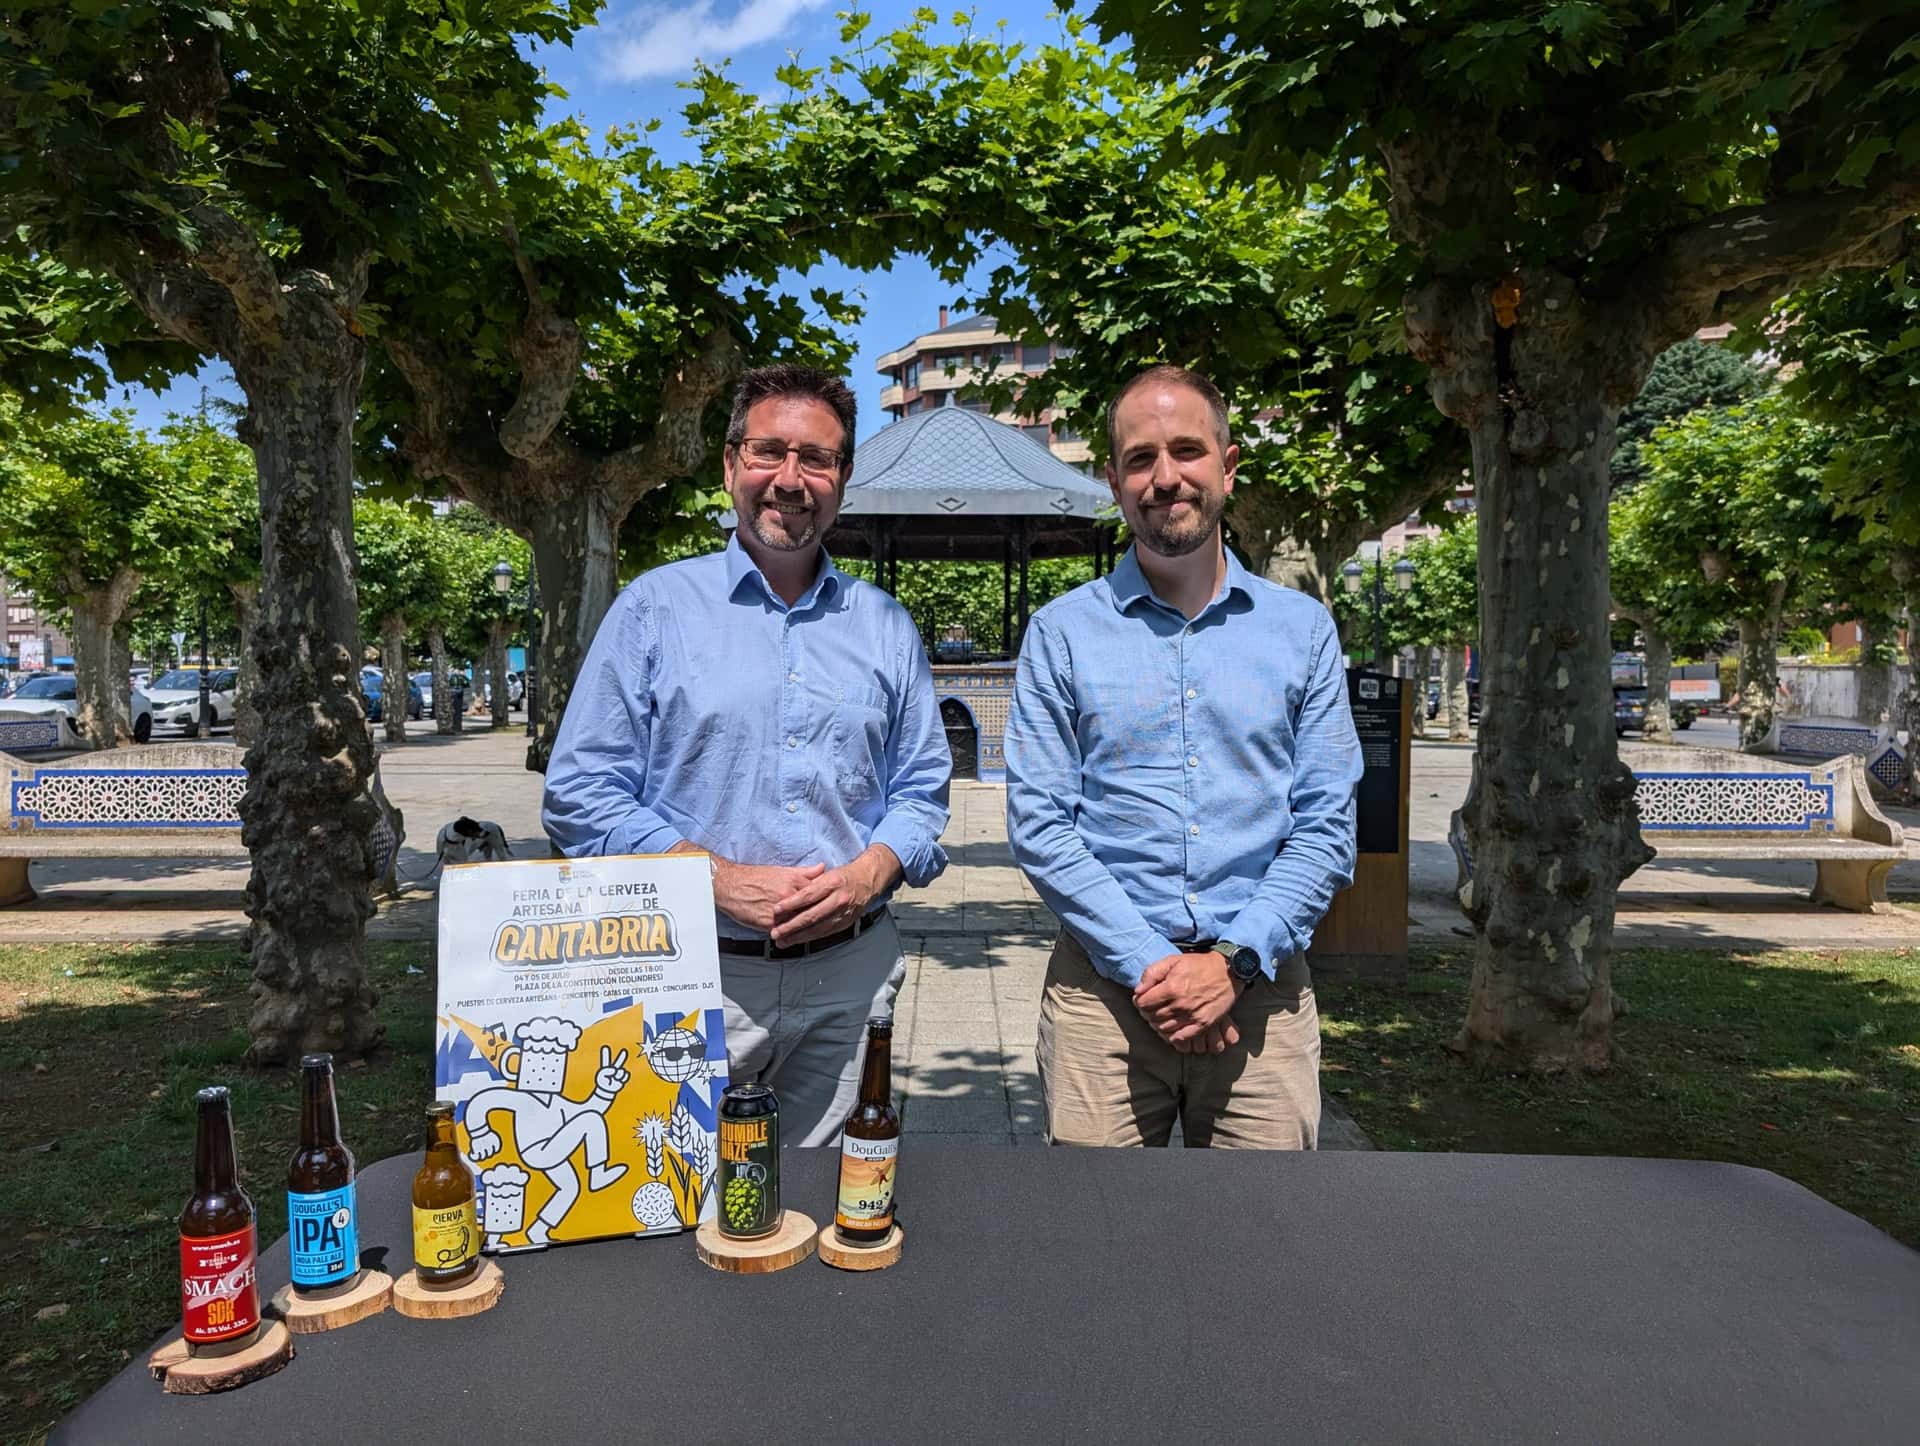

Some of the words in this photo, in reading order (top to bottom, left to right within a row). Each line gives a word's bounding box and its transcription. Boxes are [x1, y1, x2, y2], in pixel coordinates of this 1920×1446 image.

[512, 888, 550, 901] FERIA
[556, 886, 573, 899] D
[599, 883, 658, 896] CERVEZA
[512, 902, 583, 916] ARTESANA
[642, 897, 659, 910] DE
[496, 914, 671, 962] CANTABRIA
[541, 973, 551, 981] DE
[608, 968, 629, 976] DESDE
[630, 966, 643, 974] LAS
[514, 982, 540, 991] PLAZA
[541, 981, 550, 990] DE
[551, 980, 562, 989] LA
[563, 975, 617, 988] CONSTITUCIÓN
[495, 997, 524, 1005] CERVEZA
[603, 988, 621, 997] CATAS
[631, 985, 659, 995] CERVEZA
[294, 1200, 340, 1214] DOUGALL'S
[858, 1200, 883, 1210] 942
[295, 1216, 341, 1253] IPA
[184, 1265, 256, 1297] SMACH
